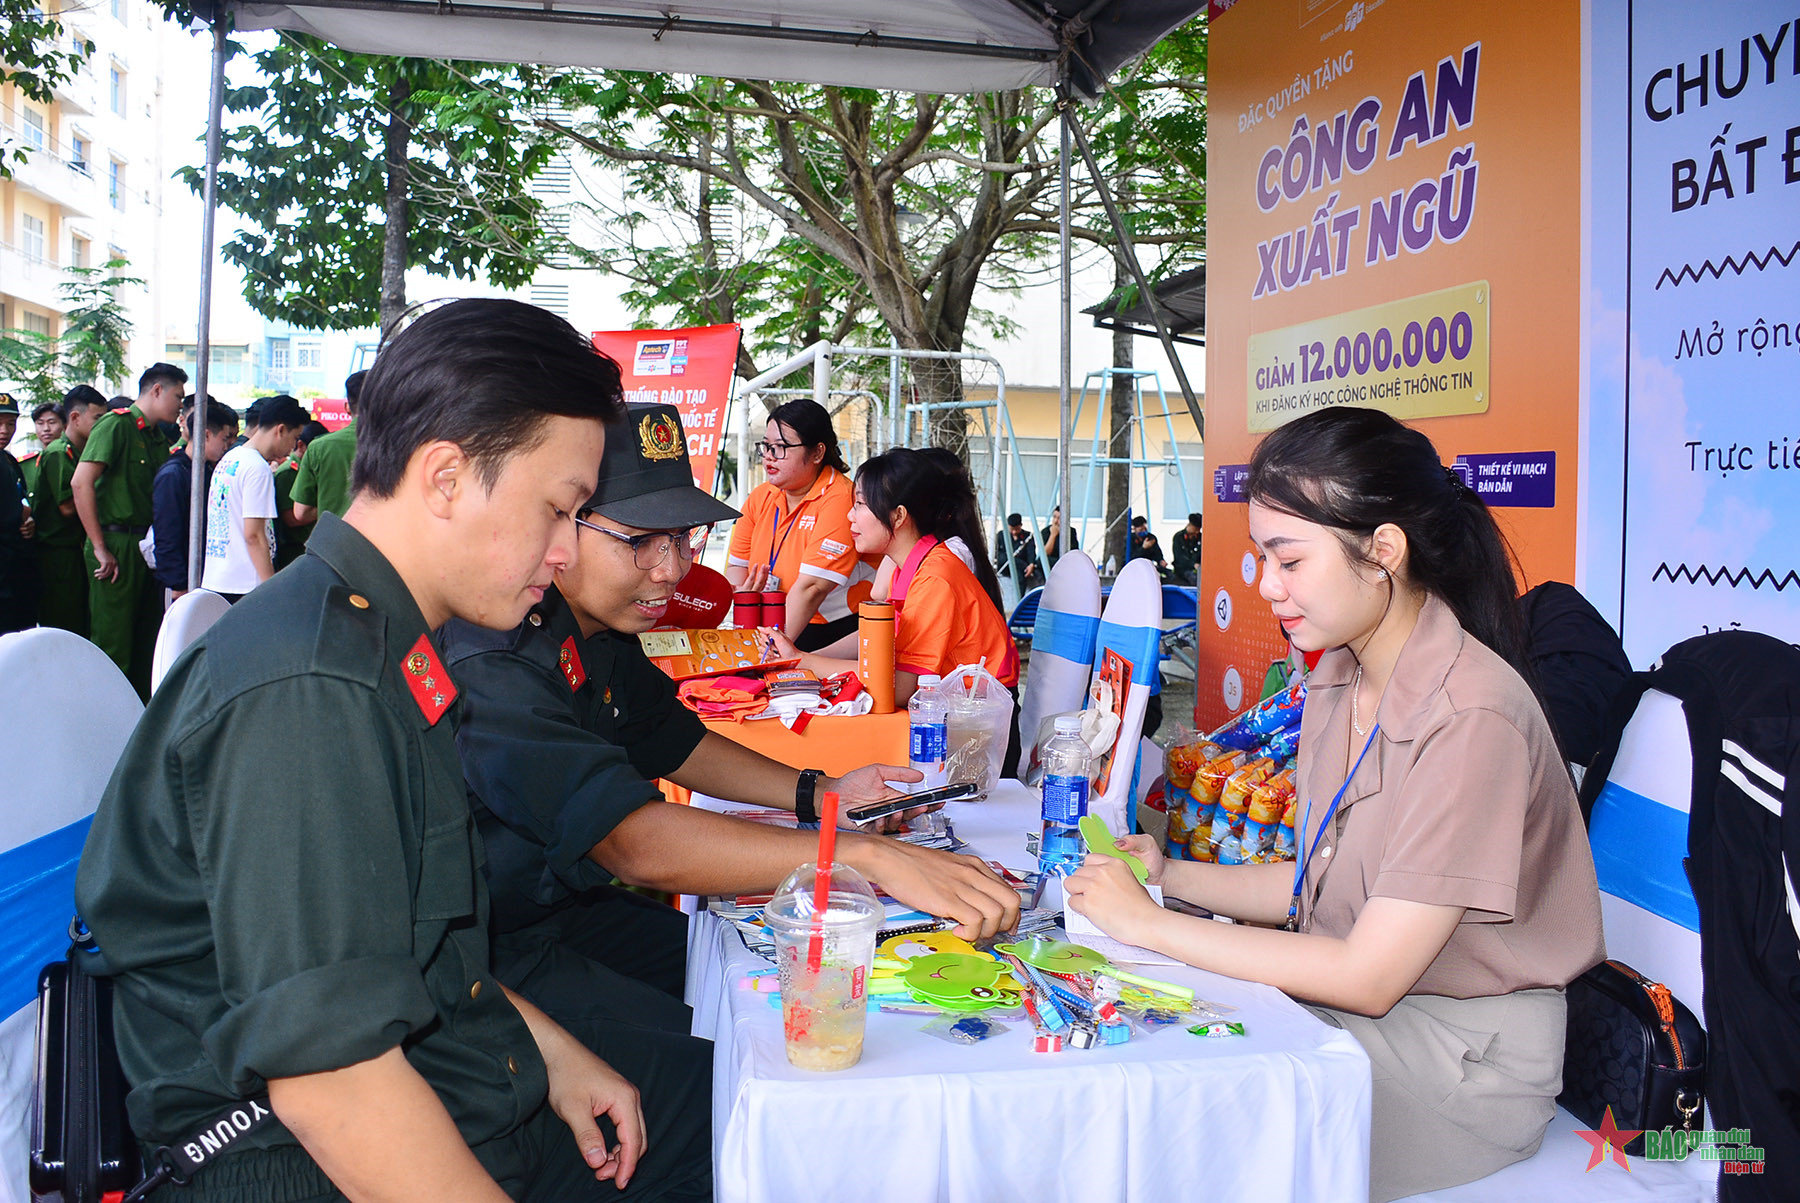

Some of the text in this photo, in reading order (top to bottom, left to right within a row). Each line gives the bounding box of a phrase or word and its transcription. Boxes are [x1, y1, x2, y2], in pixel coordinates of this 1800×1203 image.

[1644, 18, 1800, 122] CHUY
[1238, 49, 1354, 134] ĐẶC QUYỀN TẶNG
[1257, 41, 1482, 213] CÔNG AN
[1672, 122, 1767, 213] BẤT
[1252, 142, 1479, 300] XUẤT NGŨ
[1255, 311, 1473, 390] GIẢM 12.000.000
[1674, 320, 1724, 360] Mở
[624, 385, 659, 403] THỐNG
[661, 386, 684, 404] ĐÀO
[685, 389, 707, 407] TẠO
[1255, 371, 1473, 414] KHI ĐĂNG KÝ HỌC CÔNG NGHỆ THÔNG TIN
[680, 407, 719, 428] UỐC TẾ
[1478, 460, 1547, 478] THIẾT KẾ VI MẠCH
[1685, 441, 1753, 478] Trực
[1478, 477, 1512, 492] BÁN DẪN
[798, 520, 815, 531] FPT
[672, 592, 713, 610] SULECO
[184, 1100, 269, 1162] YOUNG
